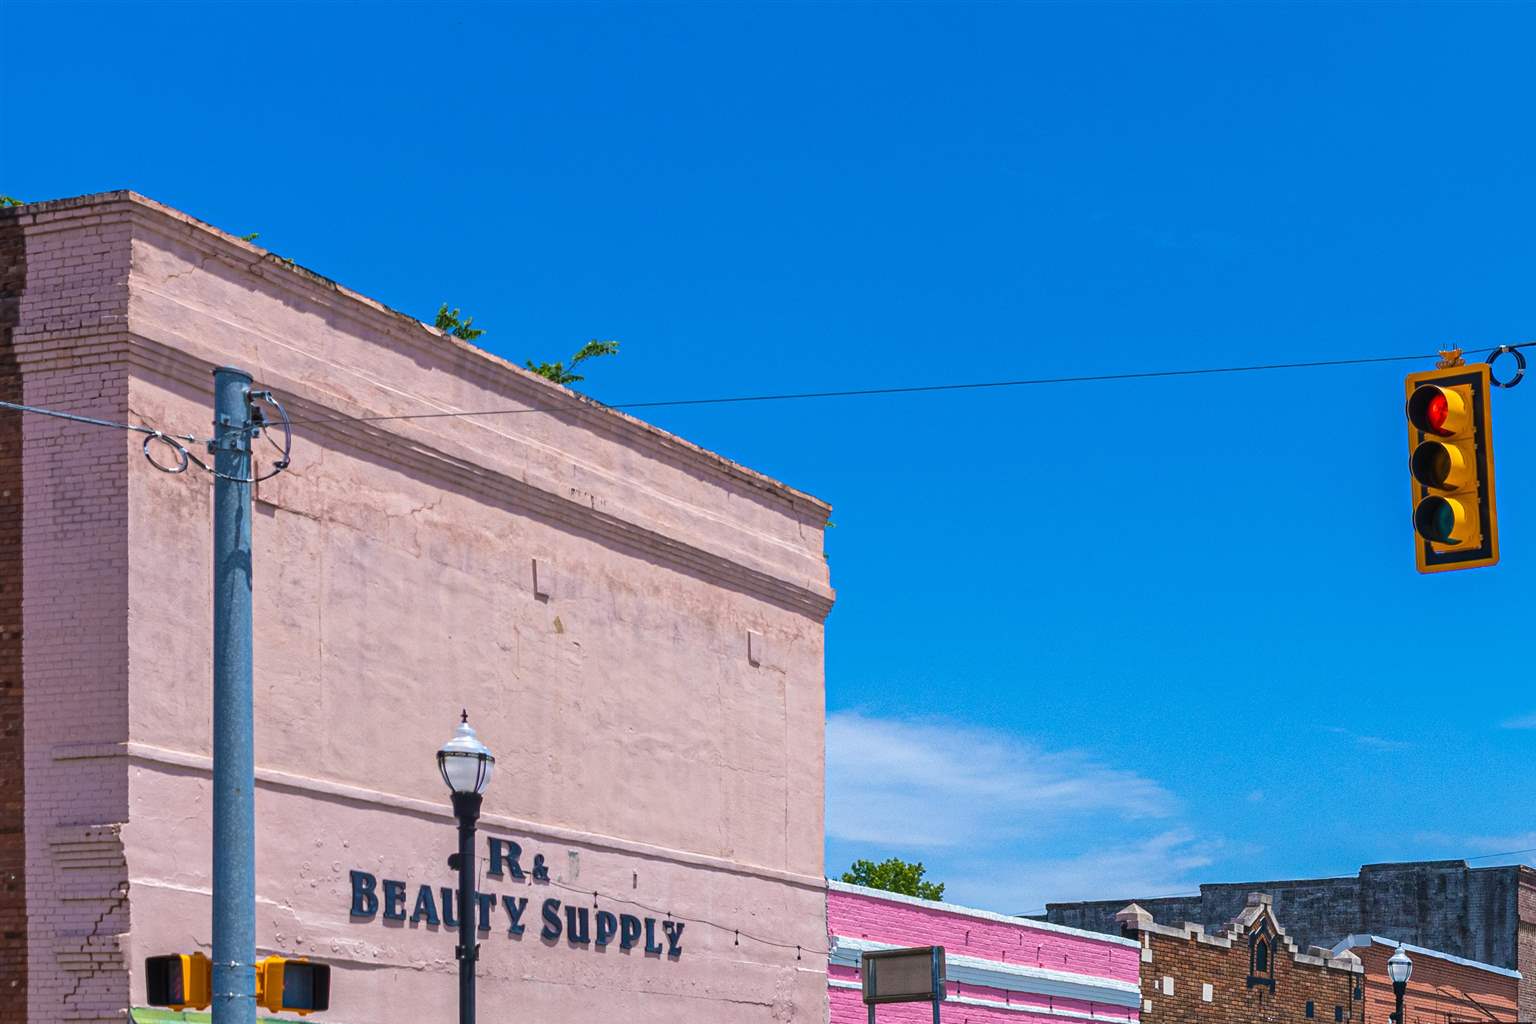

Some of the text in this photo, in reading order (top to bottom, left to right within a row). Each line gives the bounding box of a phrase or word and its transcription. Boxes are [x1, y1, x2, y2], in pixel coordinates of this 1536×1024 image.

[487, 836, 550, 881] R &
[350, 870, 685, 956] BEAUTY SUPPLY
